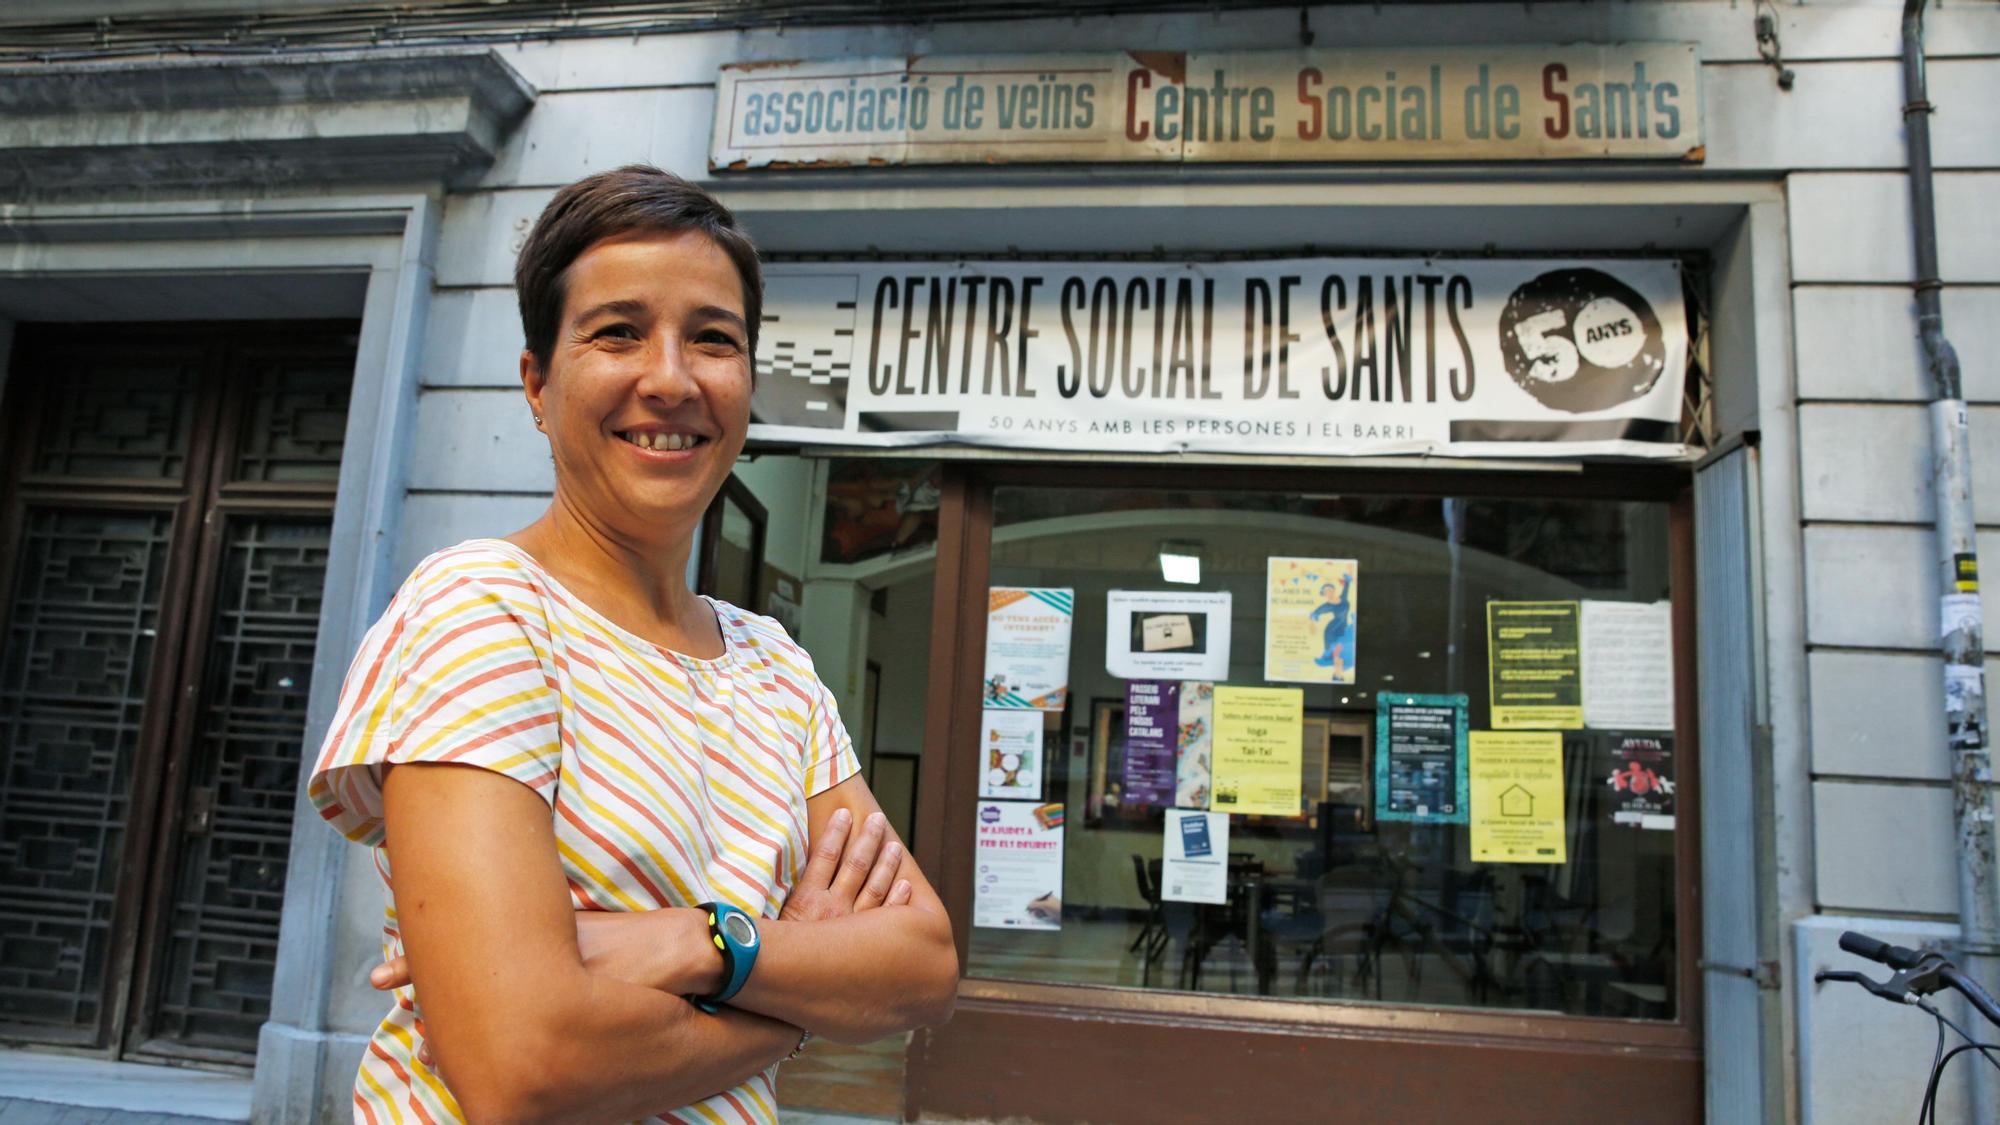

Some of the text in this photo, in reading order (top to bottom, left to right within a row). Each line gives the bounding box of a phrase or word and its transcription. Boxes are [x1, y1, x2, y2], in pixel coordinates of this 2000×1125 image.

[743, 74, 1096, 136] associació de veïns
[1125, 61, 1681, 143] Centre Social de Sants
[868, 274, 1477, 404] CENTRE SOCIAL DE SANTS
[1586, 318, 1633, 344] ANYS
[990, 415, 1414, 439] 50 ANYS AMB LES PERSONES I EL BARRI
